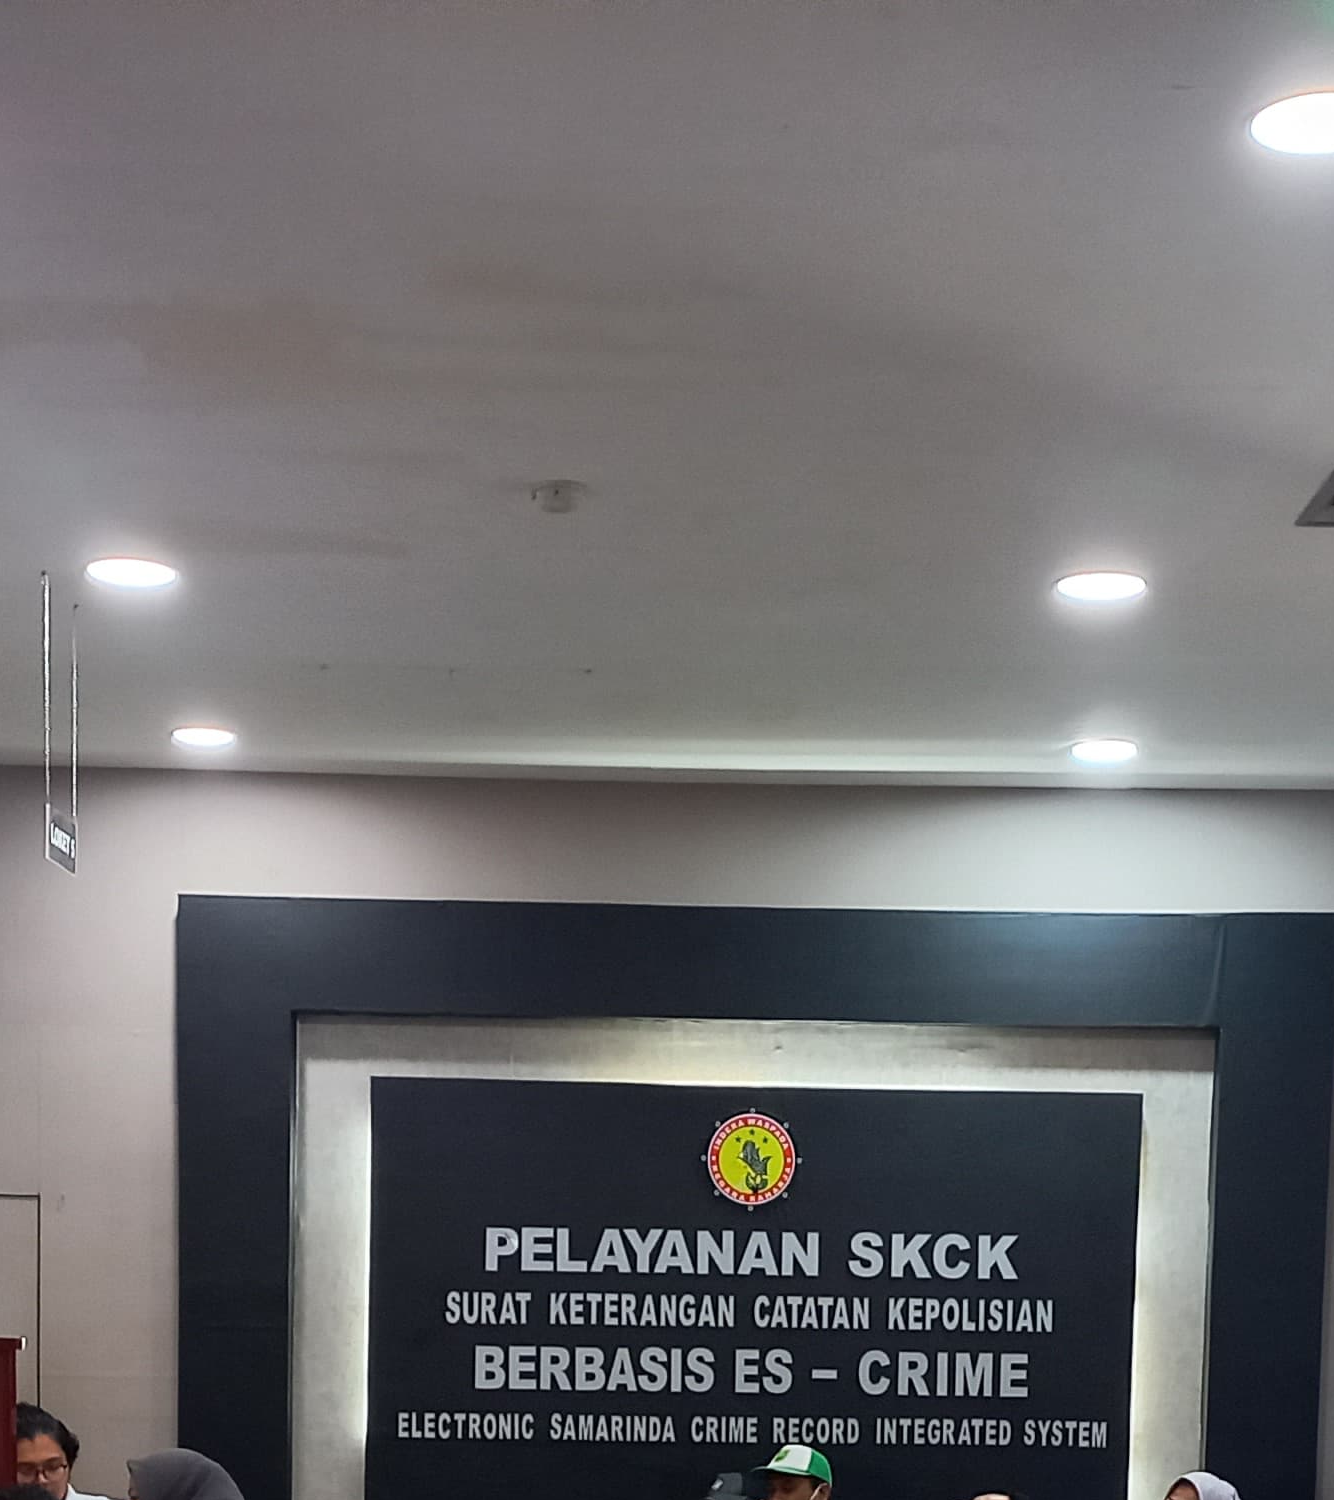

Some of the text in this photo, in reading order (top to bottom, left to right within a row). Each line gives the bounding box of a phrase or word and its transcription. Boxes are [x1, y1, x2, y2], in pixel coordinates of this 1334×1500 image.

[484, 1227, 1019, 1280] PELAYANAN SKCK
[445, 1290, 1054, 1333] SURAT KETERANGAN CATATAN KEPOLISIAN
[474, 1344, 716, 1393] BERBASIS
[733, 1348, 794, 1395] ES
[857, 1349, 1030, 1399] CRIME
[397, 1411, 1109, 1449] ELECTRONIC SAMARINDA CRIME RECORD INTEGRATED SYSTEM
